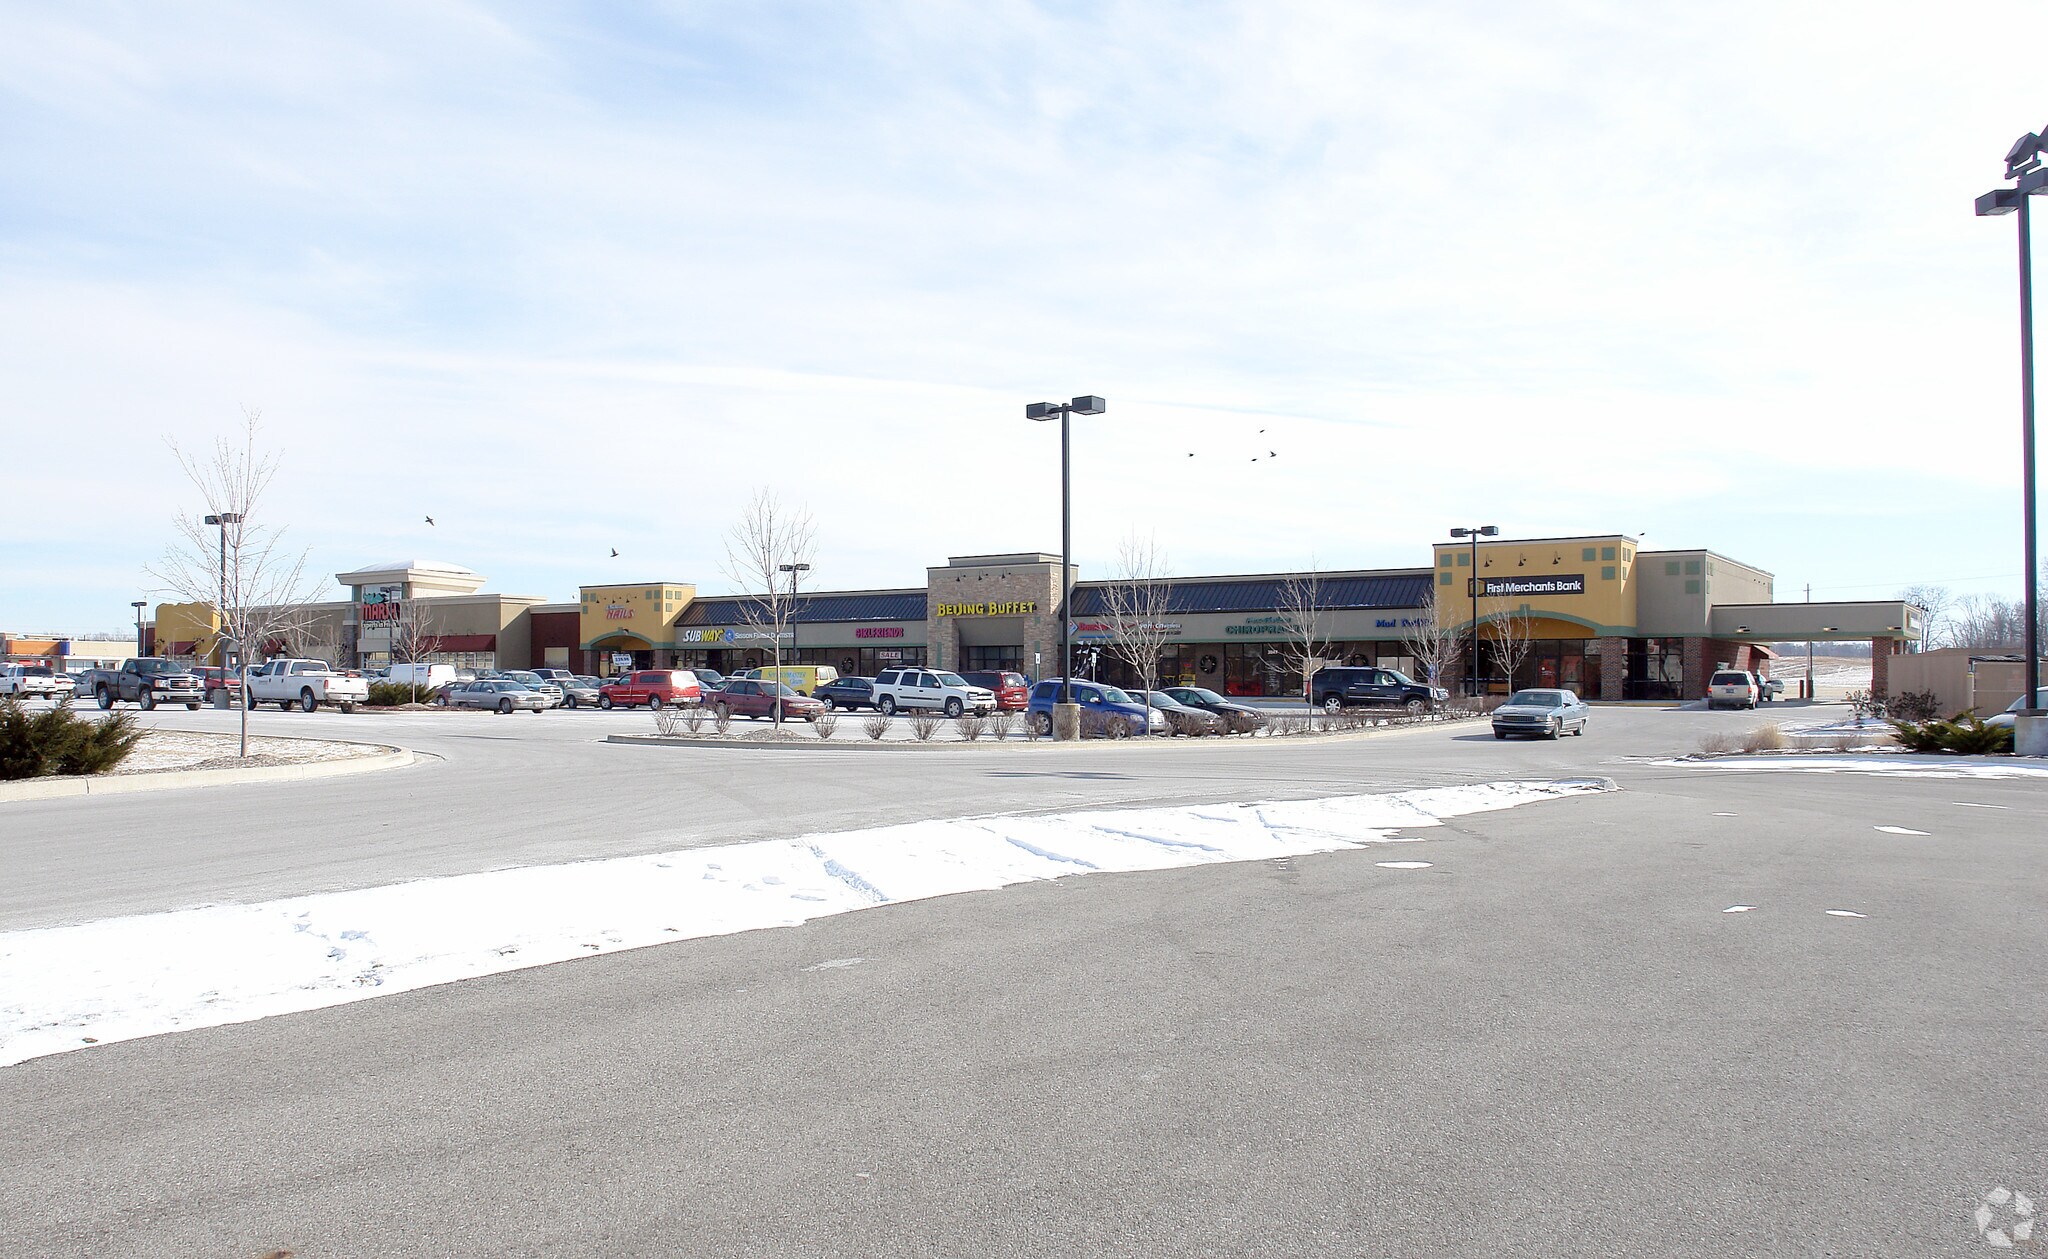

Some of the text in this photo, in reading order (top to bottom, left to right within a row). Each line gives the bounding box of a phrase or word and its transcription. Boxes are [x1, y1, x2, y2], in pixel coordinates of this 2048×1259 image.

[1486, 580, 1582, 593] First Merchants Bank
[606, 609, 634, 619] NAILS
[937, 601, 1035, 616] BEIJING BUFFET
[1376, 618, 1396, 627] Mud
[683, 629, 724, 642] SUBWAY
[855, 628, 904, 638] GIRLFRIENDS
